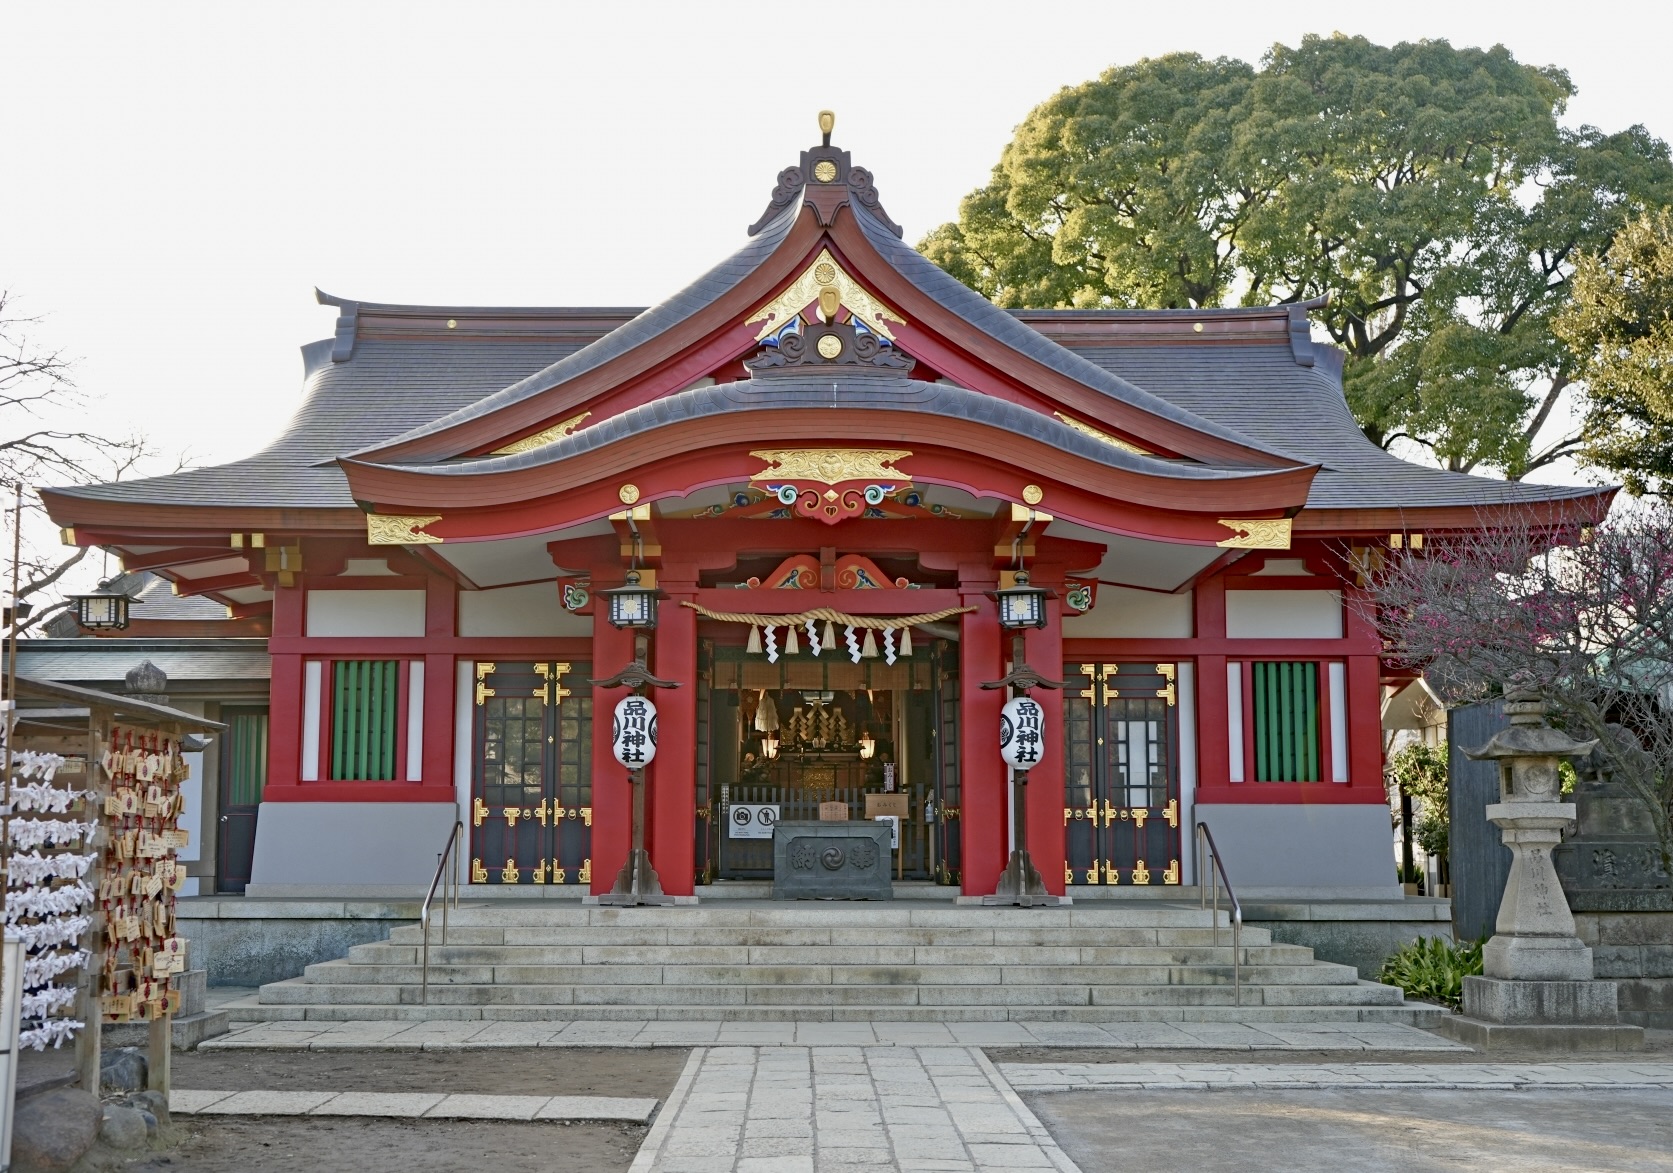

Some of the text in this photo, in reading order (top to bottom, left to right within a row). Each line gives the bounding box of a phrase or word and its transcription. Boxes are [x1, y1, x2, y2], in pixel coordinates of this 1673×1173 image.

[621, 701, 647, 763] 品川神社
[1014, 702, 1040, 763] 品川神社
[1529, 848, 1553, 917] 品川神社
